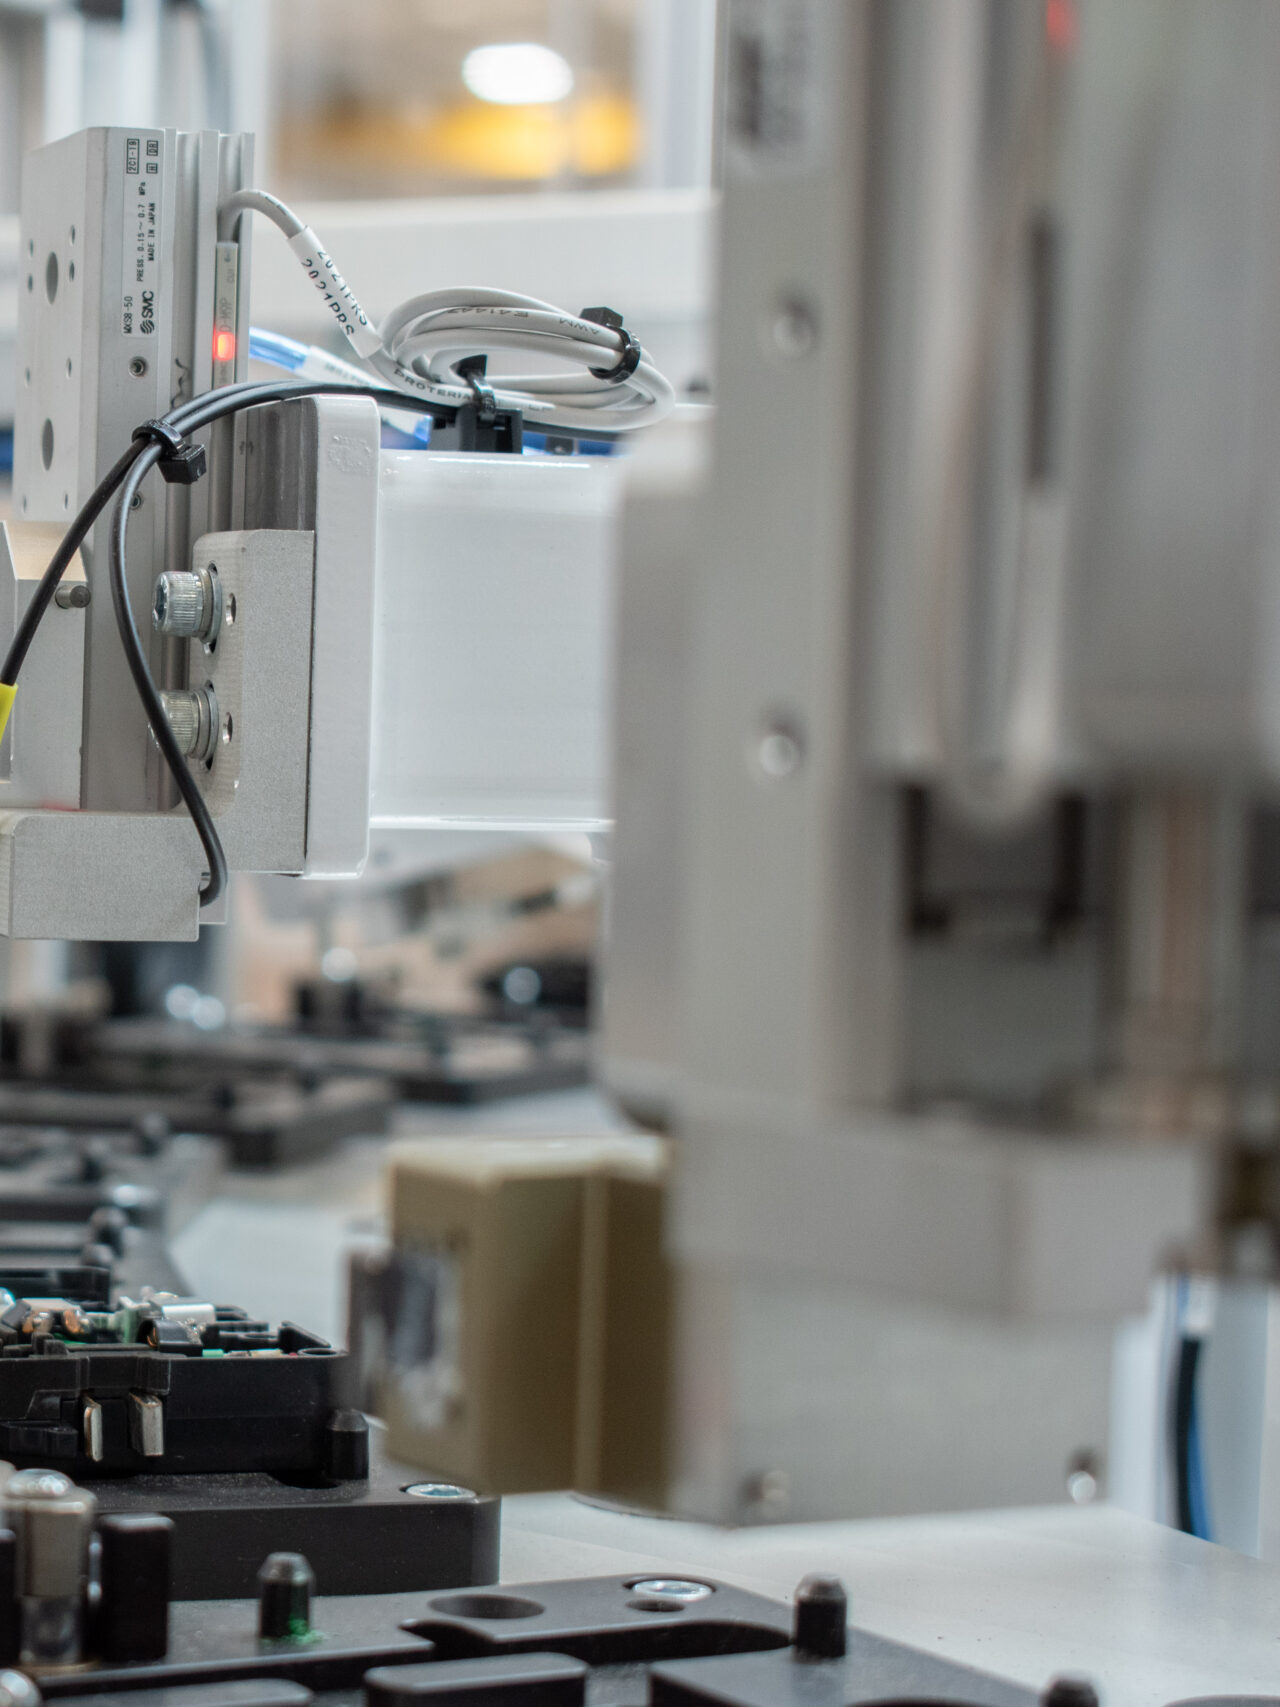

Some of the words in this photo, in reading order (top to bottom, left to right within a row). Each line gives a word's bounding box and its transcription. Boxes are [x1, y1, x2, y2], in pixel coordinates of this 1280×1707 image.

[148, 202, 156, 225] JAPAN
[137, 232, 145, 252] 0.15
[148, 229, 155, 238] IN
[147, 242, 155, 261] MADE
[136, 255, 145, 282] PRESS.
[141, 290, 154, 318] SMC
[301, 258, 355, 335] 2021PRS
[123, 296, 133, 334] MXS8-50
[559, 316, 600, 335] AWM
[393, 368, 472, 399] PROTERIA
